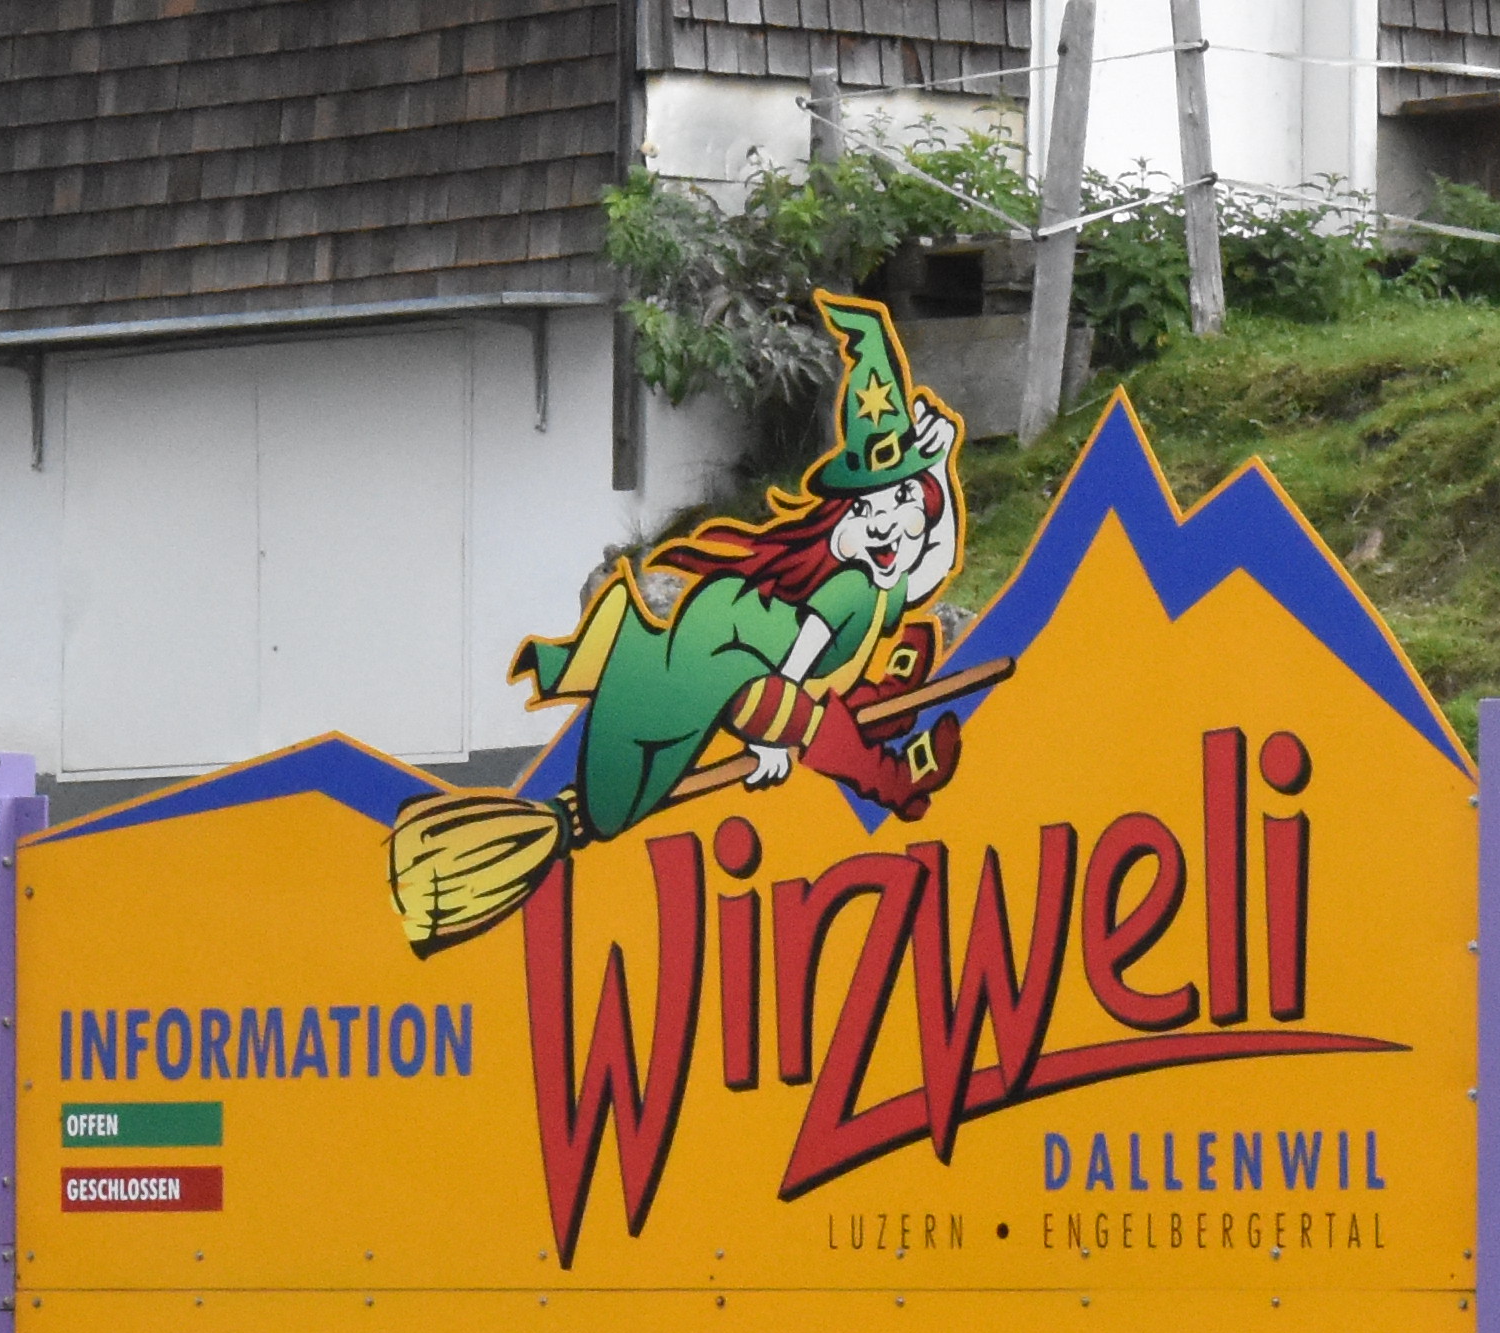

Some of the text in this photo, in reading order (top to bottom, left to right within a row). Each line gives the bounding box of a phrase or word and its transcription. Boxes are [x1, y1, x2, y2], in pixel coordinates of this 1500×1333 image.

[521, 728, 1314, 1268] Wirzweli
[61, 1003, 473, 1082] INFORMATION
[66, 1112, 119, 1138] OFFEN
[1043, 1129, 1386, 1192] DALLENWIL
[66, 1177, 181, 1203] GESCHLOSSEN
[828, 1212, 1386, 1252] LUZERN ENGELBERGERTAL
